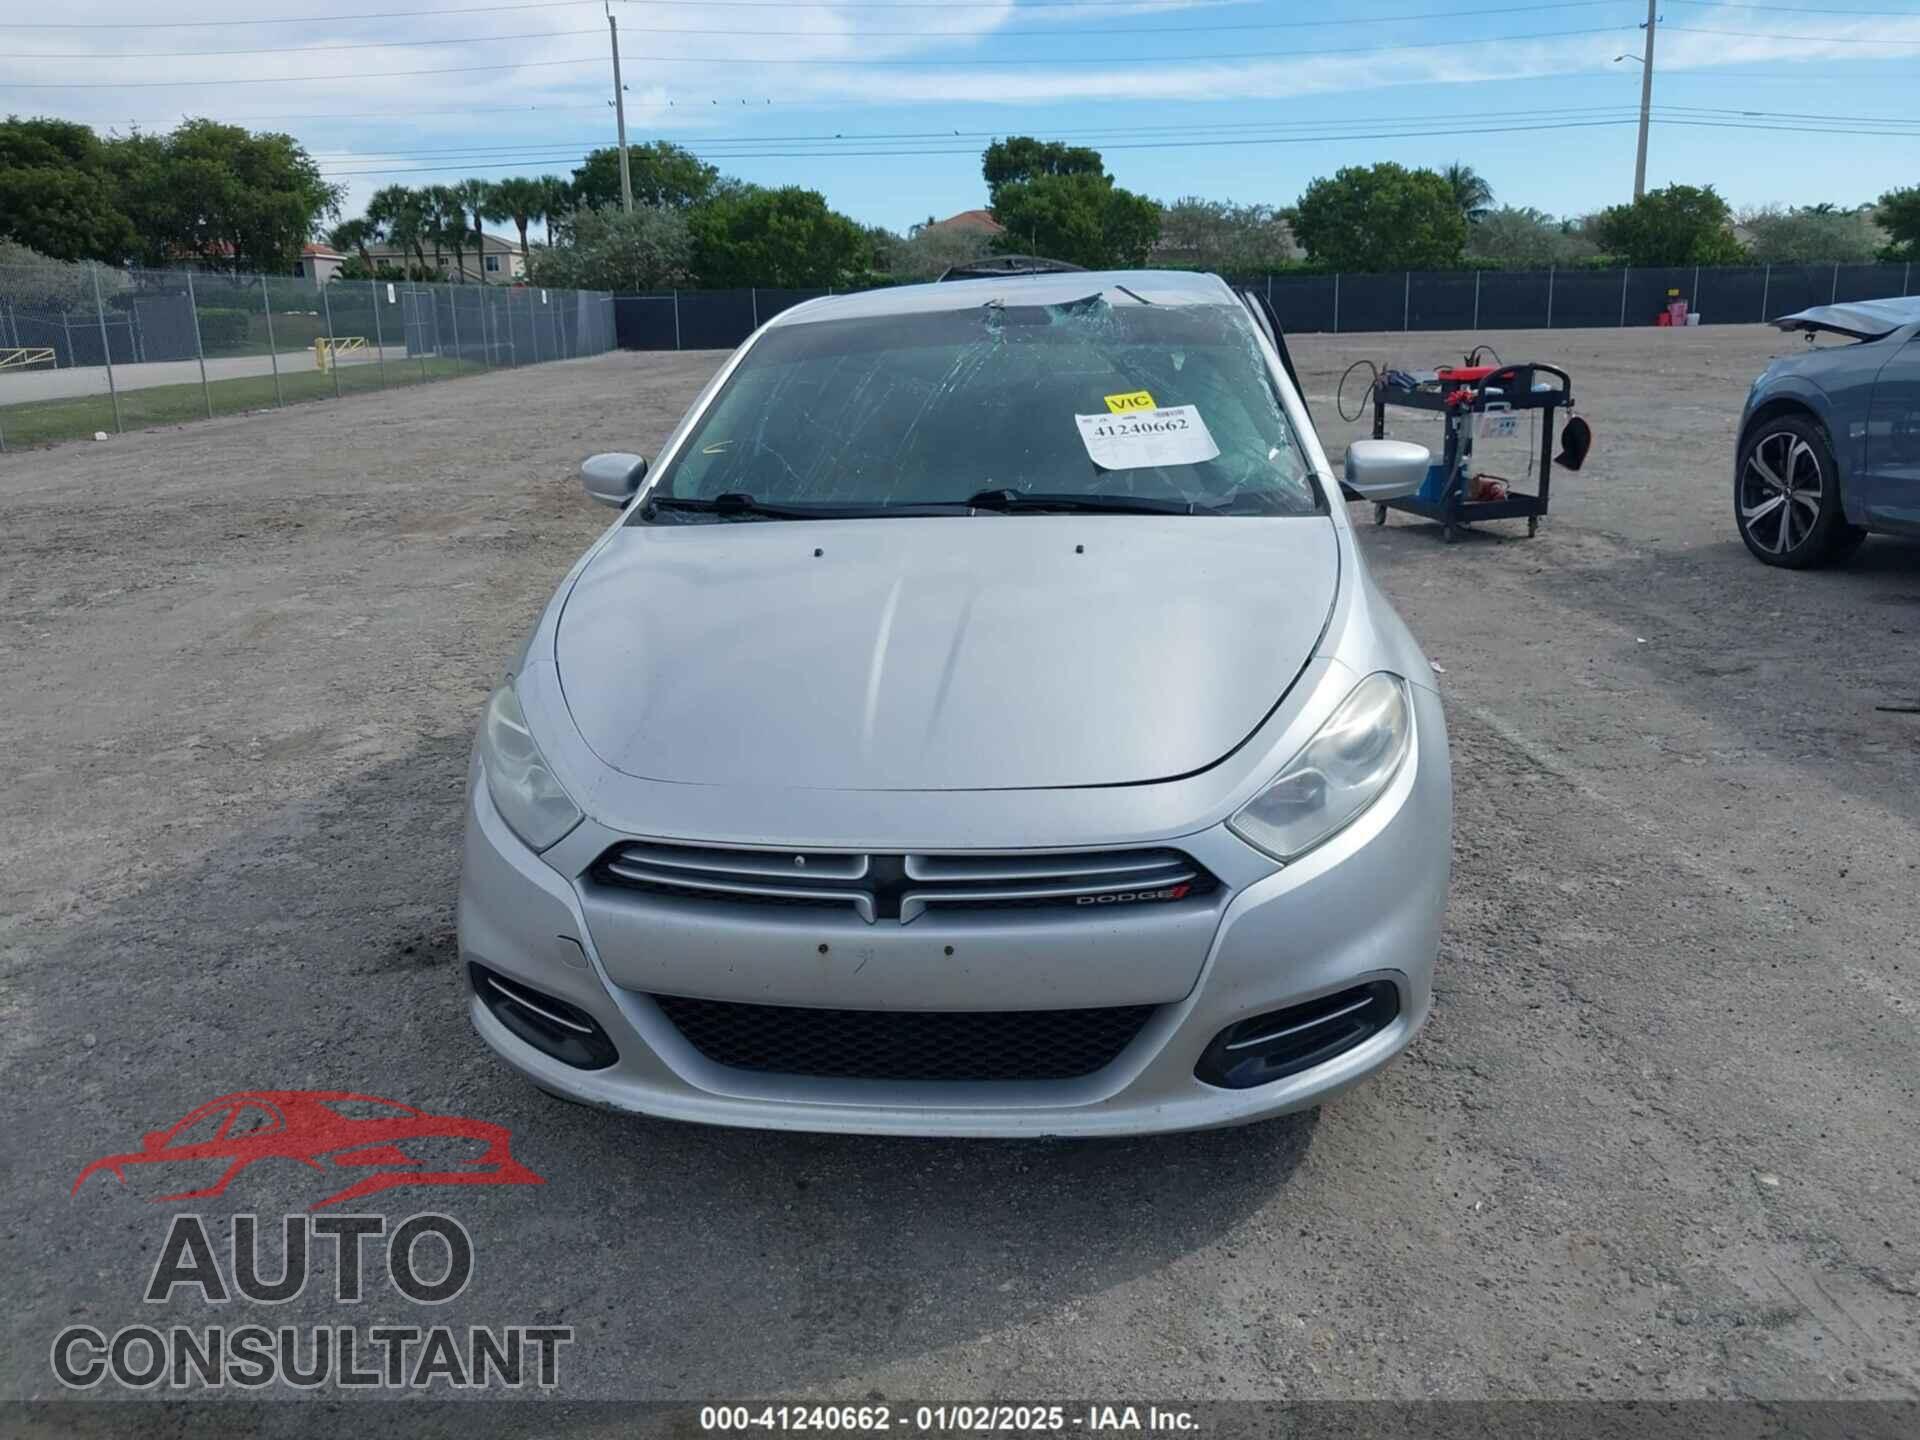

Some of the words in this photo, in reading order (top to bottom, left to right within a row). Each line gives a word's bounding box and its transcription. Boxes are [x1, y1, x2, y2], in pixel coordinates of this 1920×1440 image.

[1111, 396, 1150, 409] VIC
[1095, 419, 1189, 436] 41240662
[1076, 890, 1174, 904] DODGE
